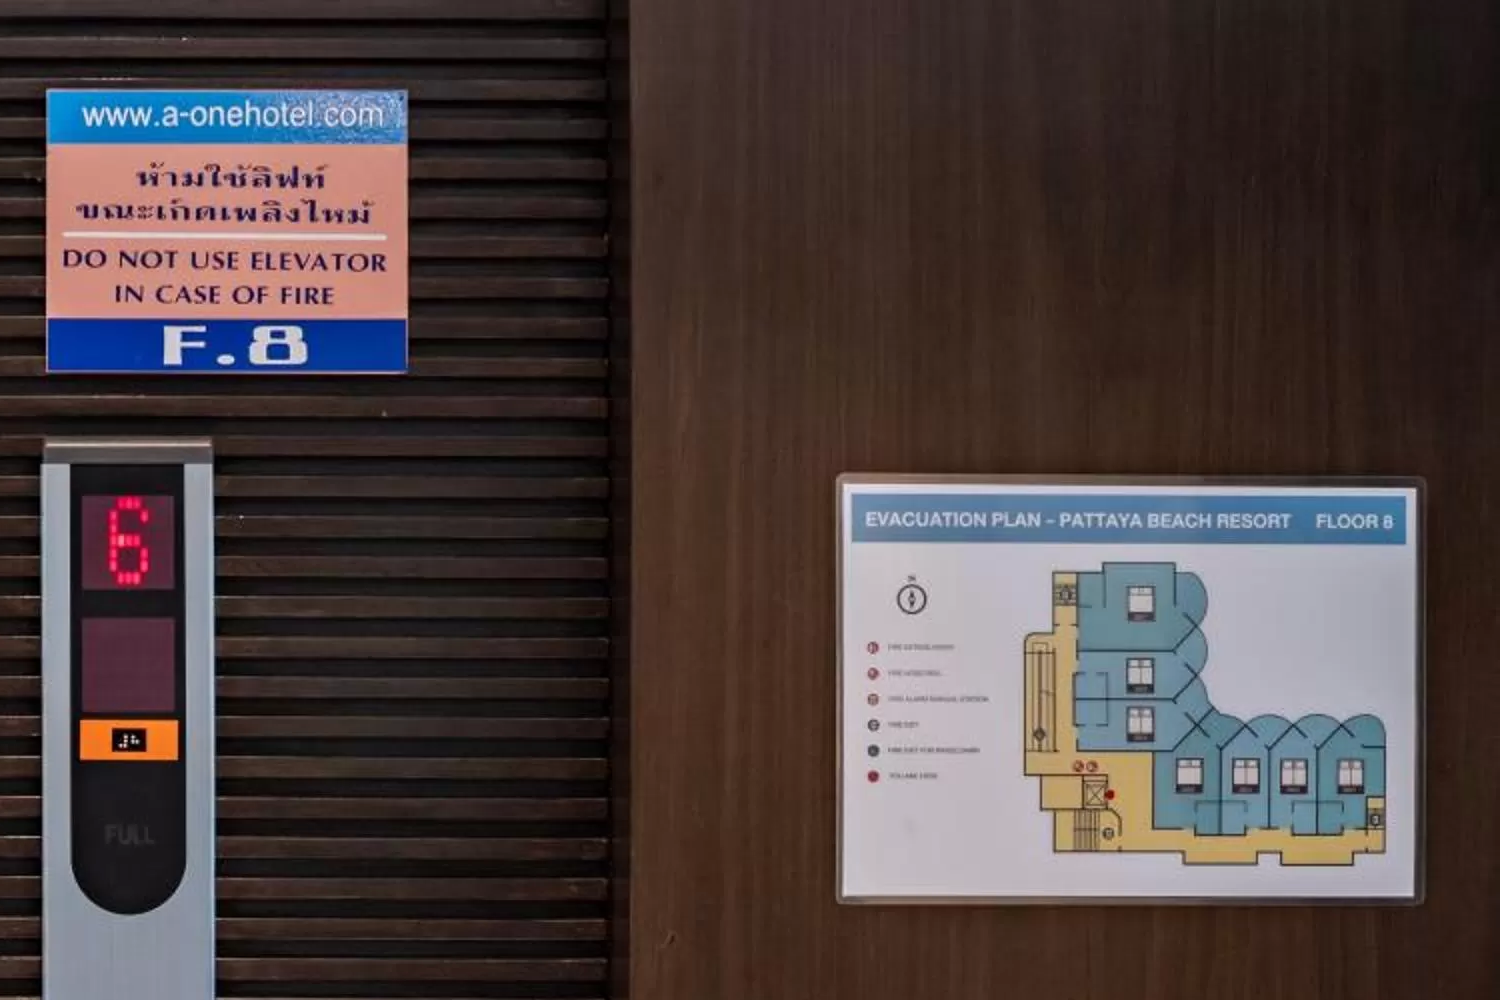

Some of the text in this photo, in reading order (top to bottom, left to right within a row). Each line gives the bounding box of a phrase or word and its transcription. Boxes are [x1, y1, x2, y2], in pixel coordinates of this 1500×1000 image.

[81, 100, 385, 128] www.a-onehotel.com
[63, 249, 388, 273] DO NOT USE ELEVATOR
[115, 285, 335, 305] IN CASE OF FIRE
[865, 510, 987, 528] EVACUATION
[991, 511, 1041, 528] PLAN
[1059, 511, 1143, 529] PATTAYA
[1146, 512, 1212, 529] BEACH
[1216, 512, 1293, 530] RESORT
[1316, 513, 1379, 530] FLOOR
[109, 496, 149, 586] 6
[104, 823, 155, 845] FULL
